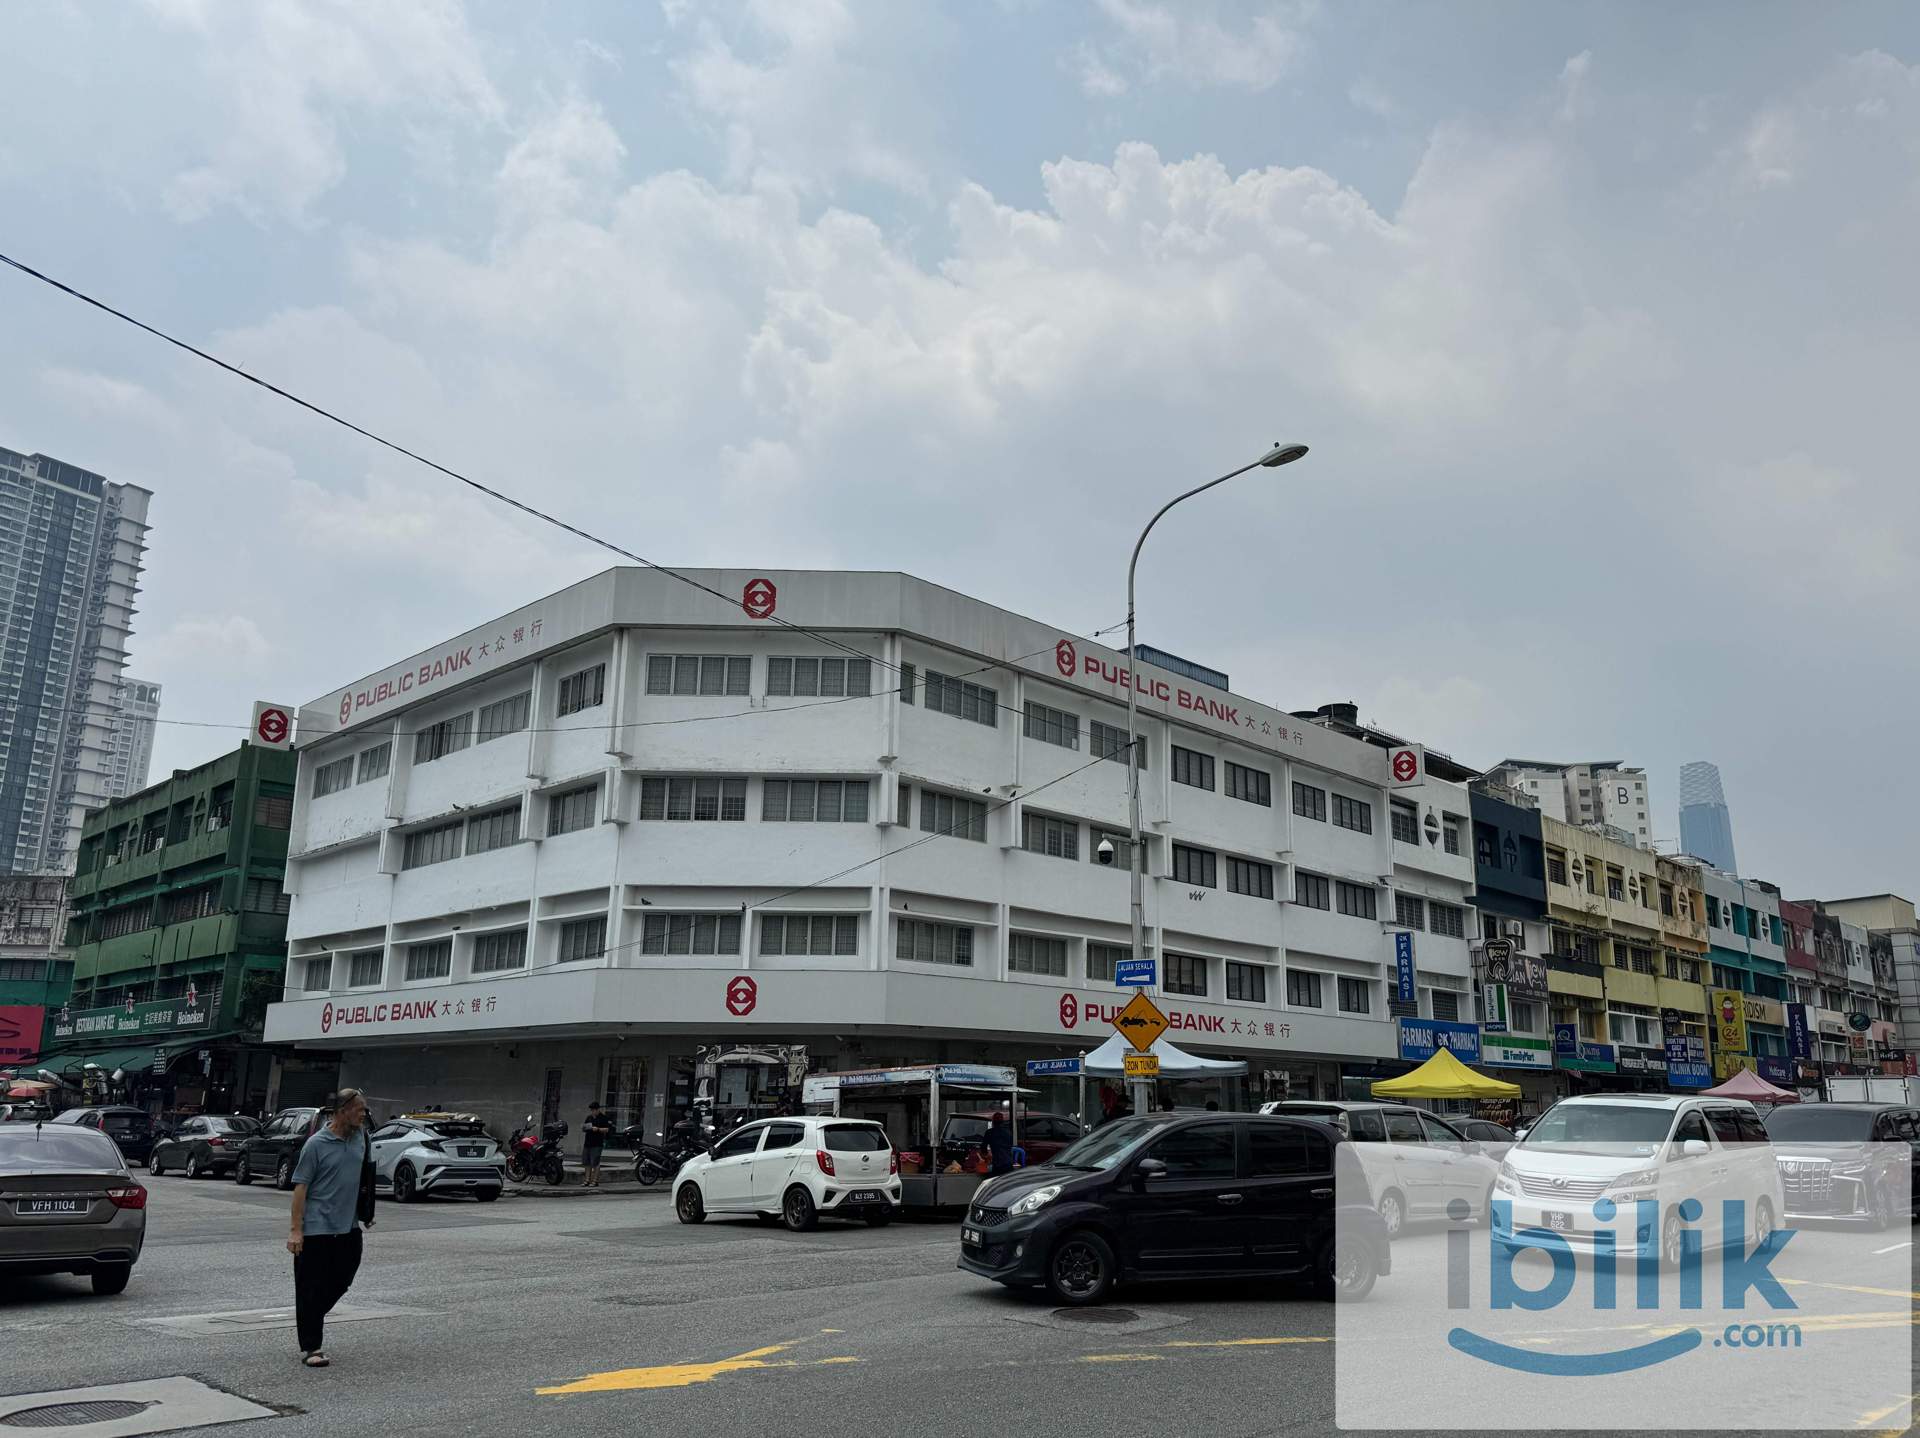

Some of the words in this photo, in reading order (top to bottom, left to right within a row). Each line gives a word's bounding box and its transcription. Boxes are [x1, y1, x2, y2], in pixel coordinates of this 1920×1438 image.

[478, 619, 543, 659] 大众银行
[355, 672, 413, 711] PUBLIC
[418, 647, 473, 685] BANK
[1084, 656, 1170, 701] PUBLIC
[1177, 688, 1239, 726] BANK
[1245, 715, 1303, 745] 大众银行
[1617, 787, 1629, 804] B
[1134, 961, 1153, 971] SEHALA
[1400, 942, 1410, 998] FARMASI
[335, 1004, 388, 1025] PUBLIC
[391, 1000, 438, 1020] BANK
[441, 996, 497, 1016] 大众银行
[76, 1017, 95, 1033] RESTORAN
[117, 1017, 140, 1030] Heineken
[177, 1010, 204, 1025] Heineken
[1169, 1012, 1225, 1033] BANK
[55, 1023, 73, 1036] Heineken
[1230, 1018, 1291, 1038] 大众银行
[1401, 1026, 1433, 1048] FARMASI
[1449, 1031, 1478, 1052] PHARMACY
[1510, 1049, 1536, 1063] FamilyMart
[1033, 1063, 1049, 1071] JALAN
[1126, 1060, 1140, 1071] ZON
[1140, 1060, 1158, 1071] TUNDA
[1669, 1063, 1691, 1075] KLINIK
[32, 1201, 52, 1210] VFH
[54, 1200, 75, 1210] 1104
